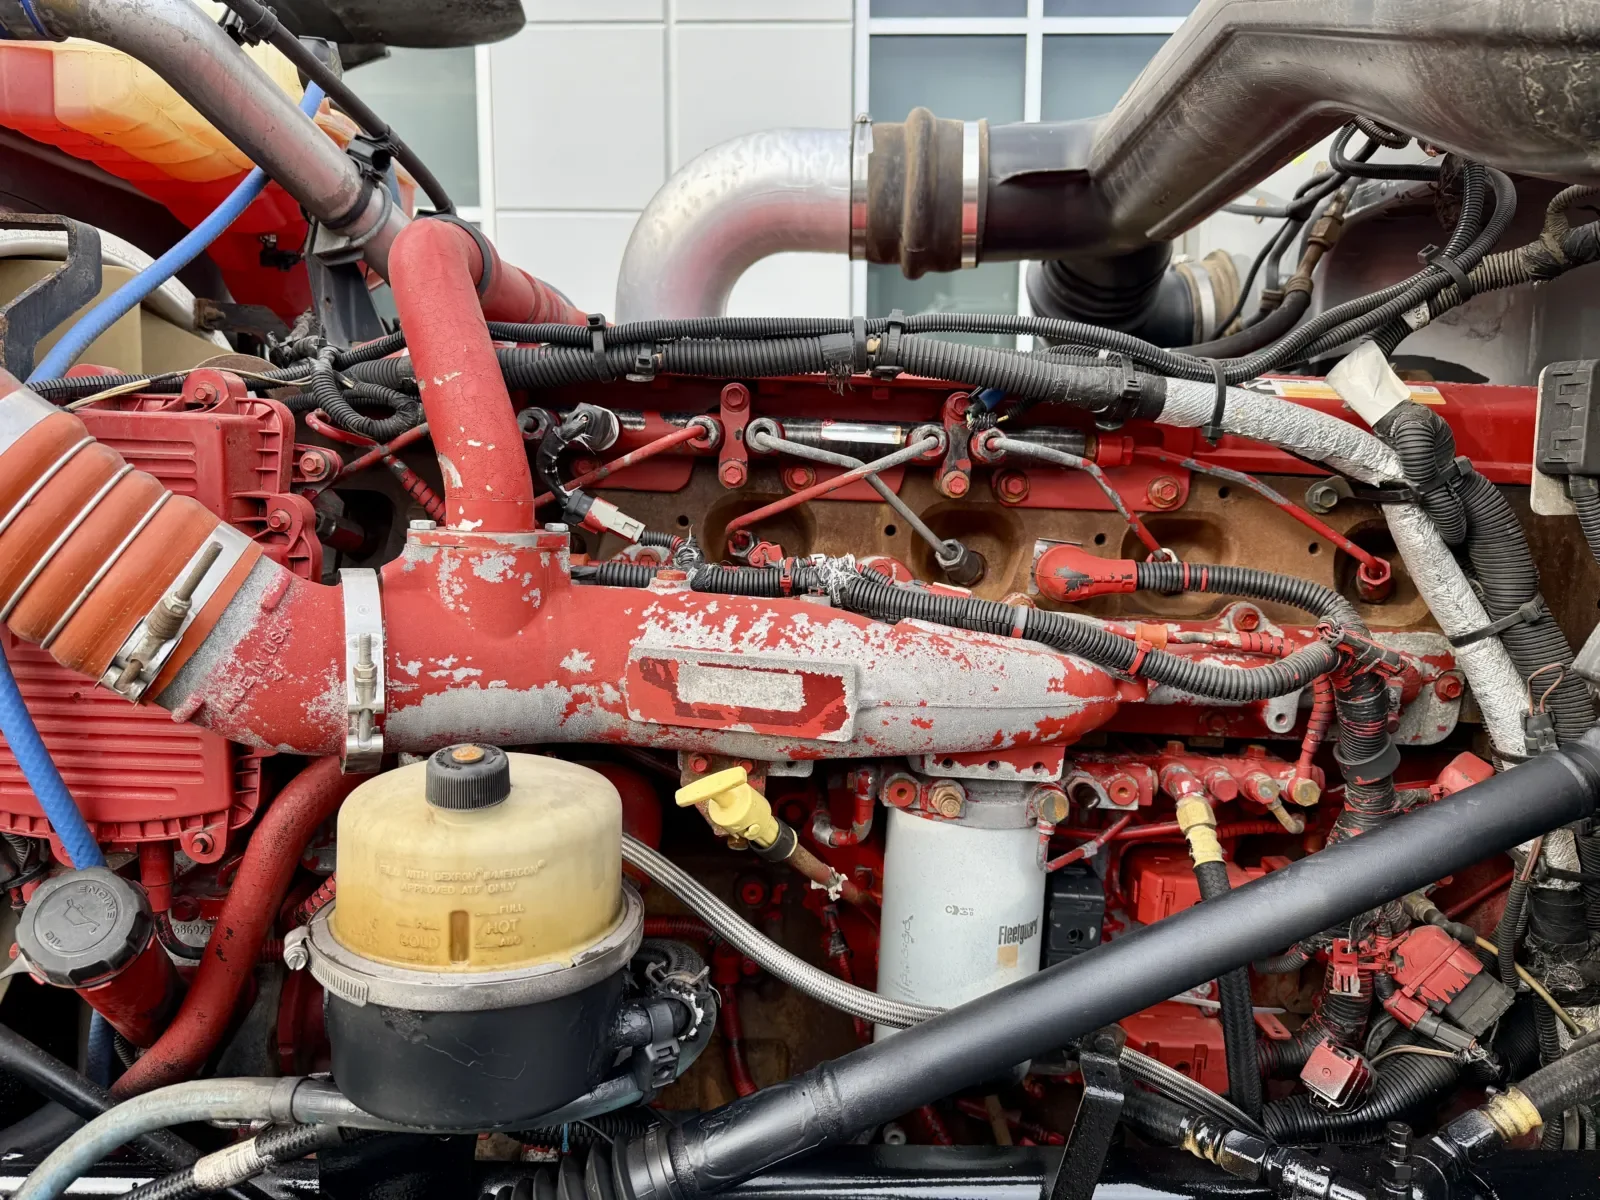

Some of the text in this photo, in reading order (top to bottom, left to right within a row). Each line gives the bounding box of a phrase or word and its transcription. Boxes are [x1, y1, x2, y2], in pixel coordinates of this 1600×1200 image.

[246, 654, 270, 675] IN
[262, 619, 292, 654] USA
[406, 868, 429, 881] WITH
[400, 881, 516, 895] APPROVED ATF ONLY
[77, 885, 116, 920] ENGINE
[499, 903, 525, 915] FULL
[486, 917, 521, 935] HOT
[44, 930, 63, 949] OIL
[399, 932, 441, 951] COLD
[499, 935, 522, 948] ADD
